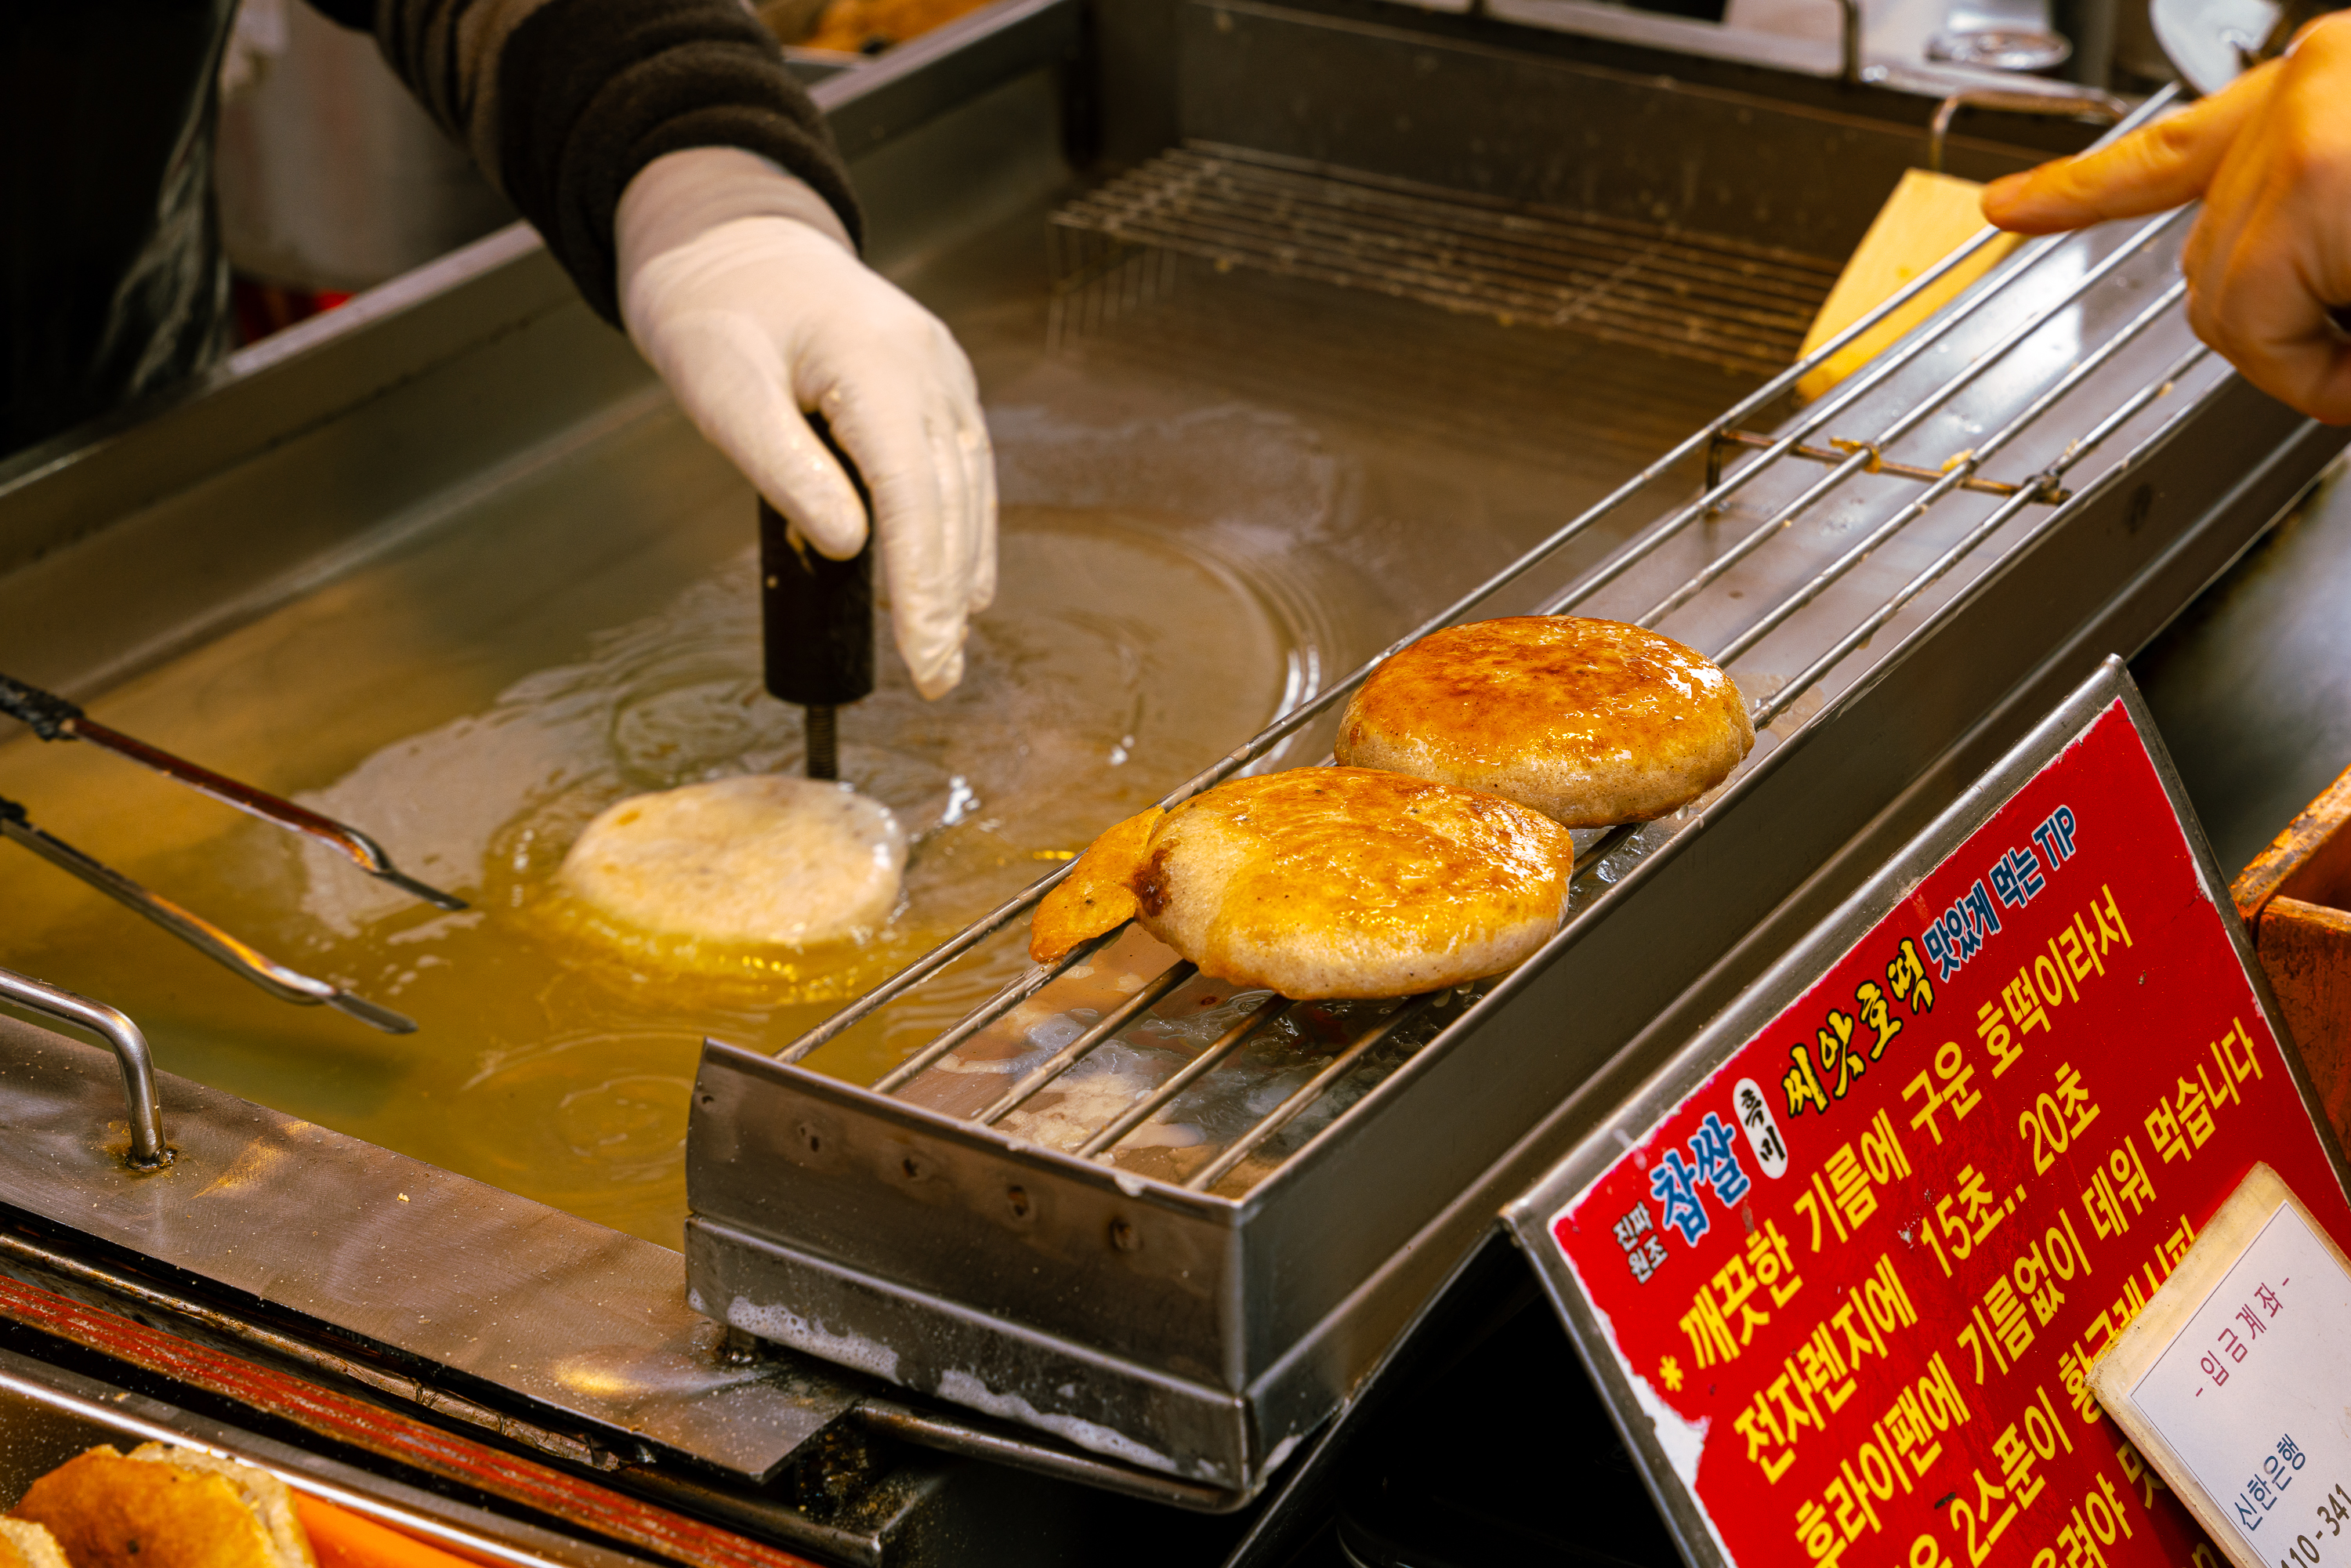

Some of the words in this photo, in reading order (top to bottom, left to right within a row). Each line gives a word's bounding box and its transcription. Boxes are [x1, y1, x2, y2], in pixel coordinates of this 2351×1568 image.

[1649, 1111, 1751, 1248] 찹쌀
[1781, 937, 1936, 1119] 씨앗호떡
[1922, 878, 2001, 983] 맛있게
[1989, 846, 2046, 908] 먹는
[2031, 805, 2077, 871] TIP
[1678, 1218, 1803, 1370] 깨끗한
[1793, 1107, 1912, 1253] 기름에
[1901, 1041, 1983, 1146] 구운
[1976, 883, 2133, 1080] 호떡이라서
[1628, 1233, 1668, 1285] 원조
[1733, 1252, 1918, 1485] 전자렌지에
[2019, 1062, 2100, 1176] 20초
[1795, 1350, 1971, 1568] 후라이팬에
[1957, 1208, 2093, 1385] 기름없이
[2081, 1135, 2157, 1240] 데워
[2143, 1016, 2263, 1164] 먹습니다
[1949, 1385, 2074, 1568] 2스푼이
[2234, 1433, 2306, 1531] 신한은행
